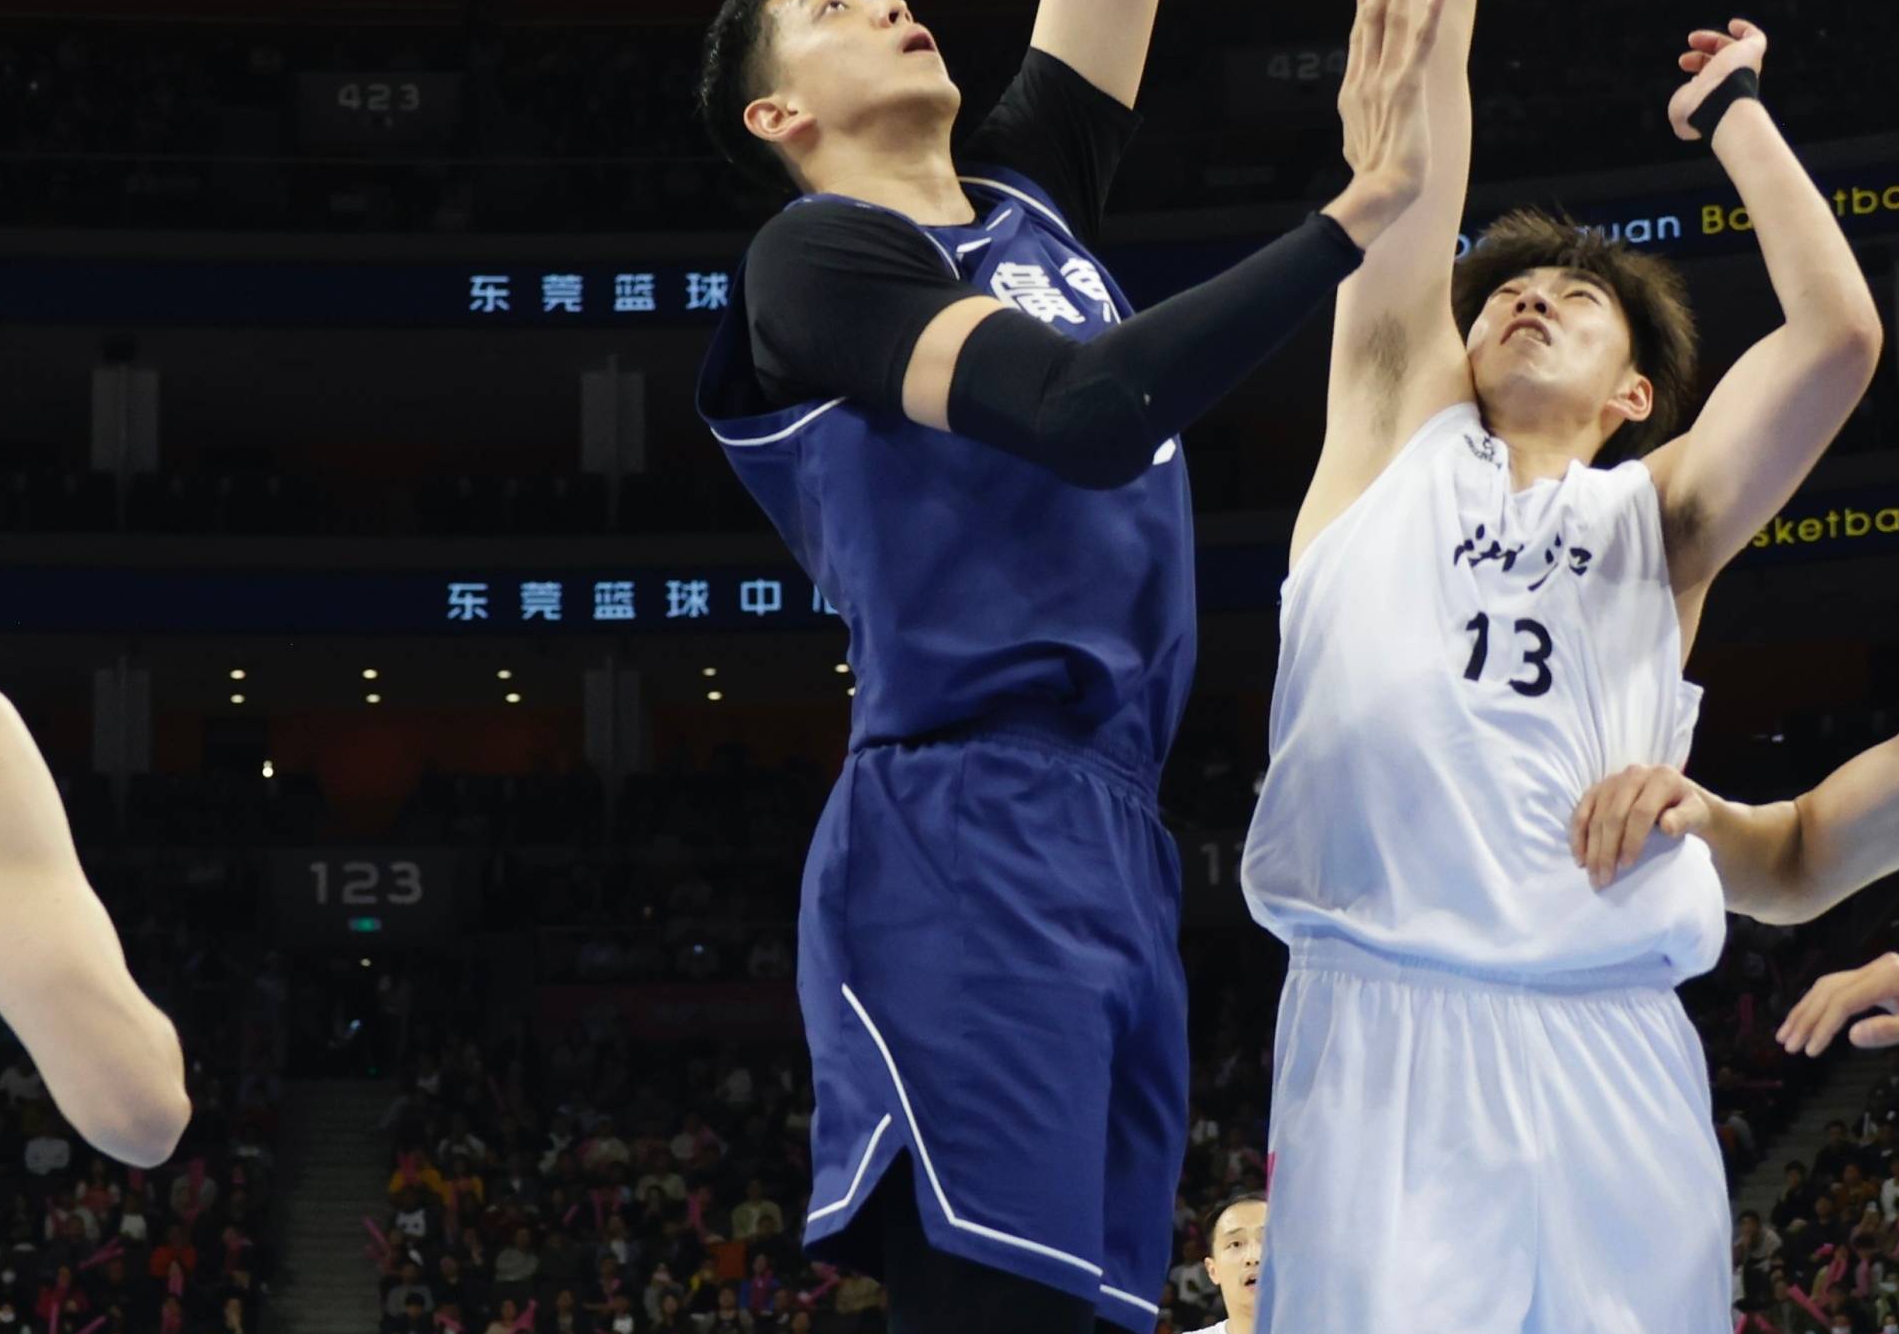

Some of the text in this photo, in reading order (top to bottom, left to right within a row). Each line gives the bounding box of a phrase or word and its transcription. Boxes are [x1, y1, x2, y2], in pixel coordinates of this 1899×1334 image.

[336, 83, 421, 113] 423
[1463, 611, 1553, 698] 13
[309, 860, 423, 906] 123
